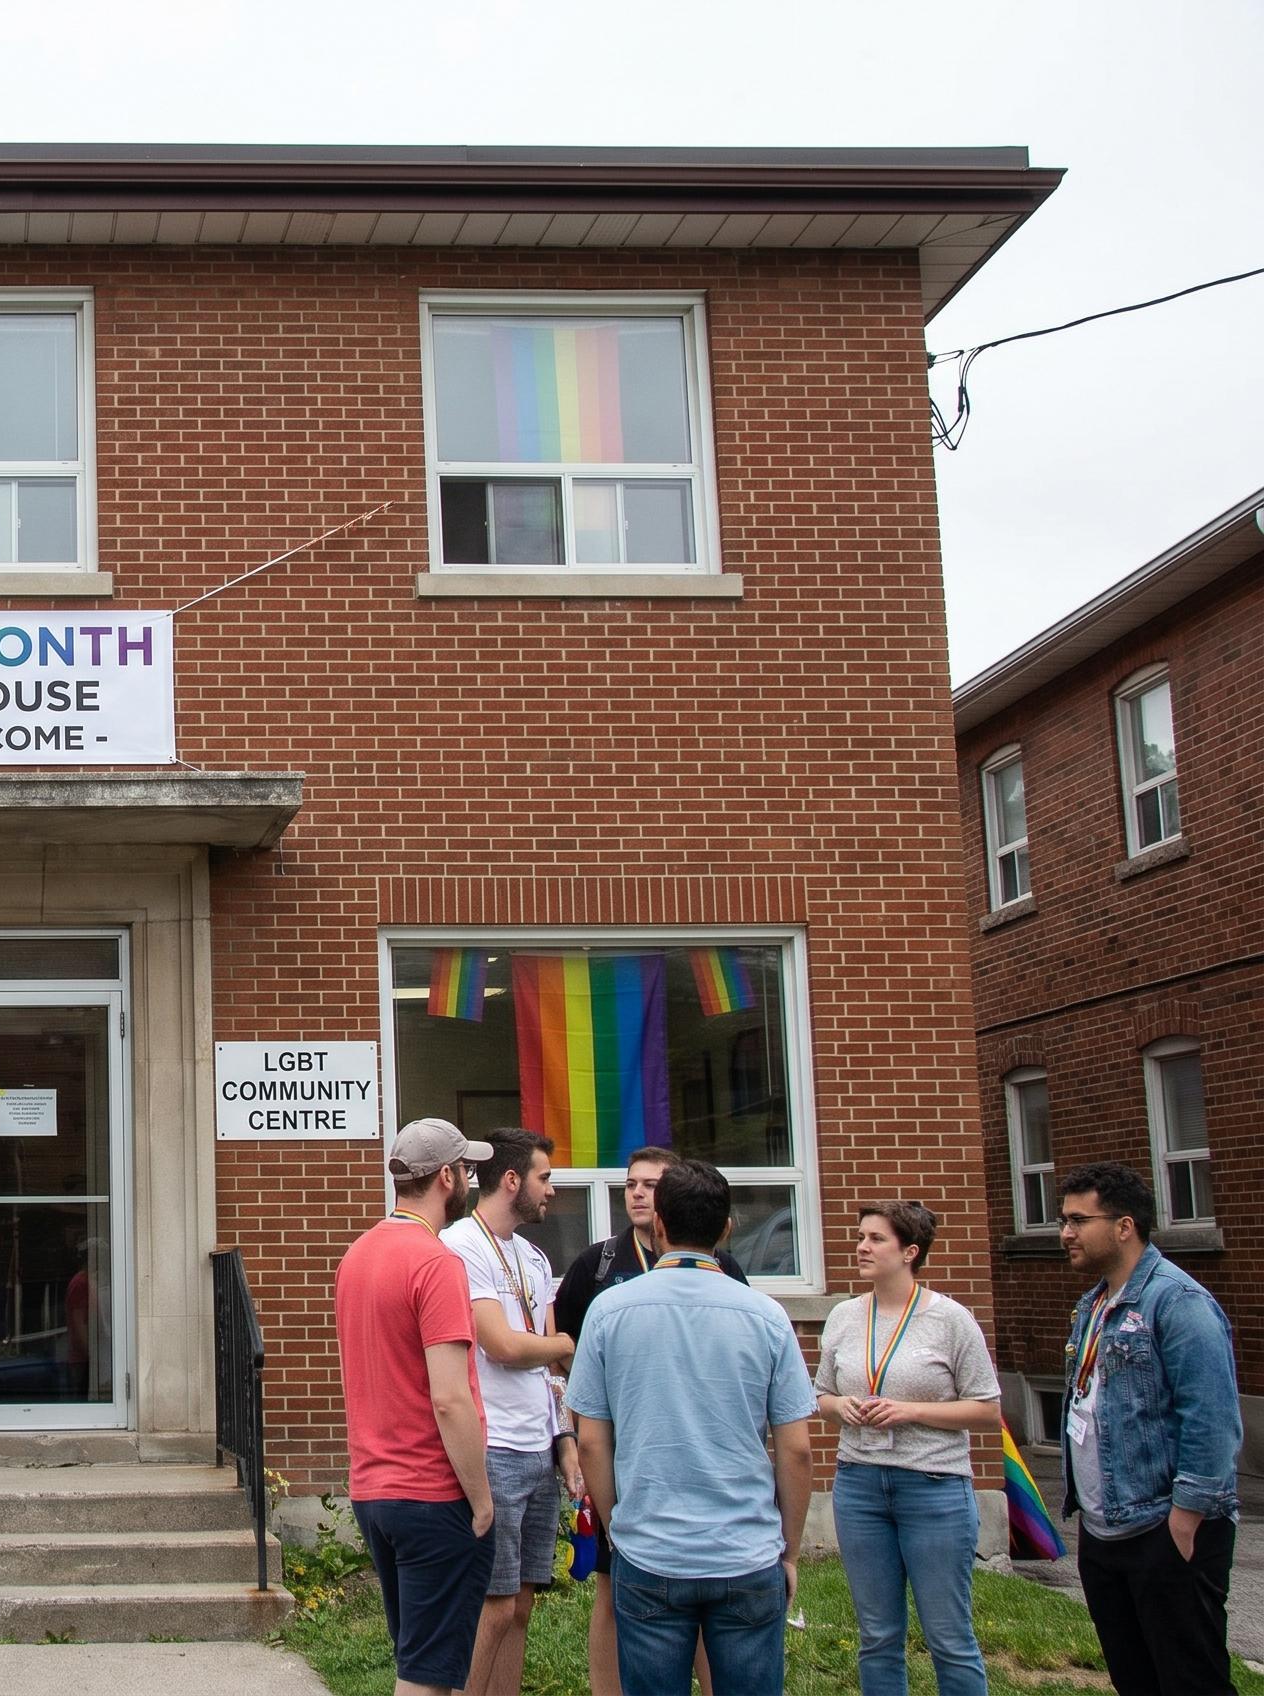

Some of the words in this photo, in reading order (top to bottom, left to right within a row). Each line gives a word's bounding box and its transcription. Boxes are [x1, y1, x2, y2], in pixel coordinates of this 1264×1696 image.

[264, 1051, 329, 1072] LGBT
[222, 1080, 372, 1102] COMMUNITY
[248, 1109, 347, 1131] CENTRE
